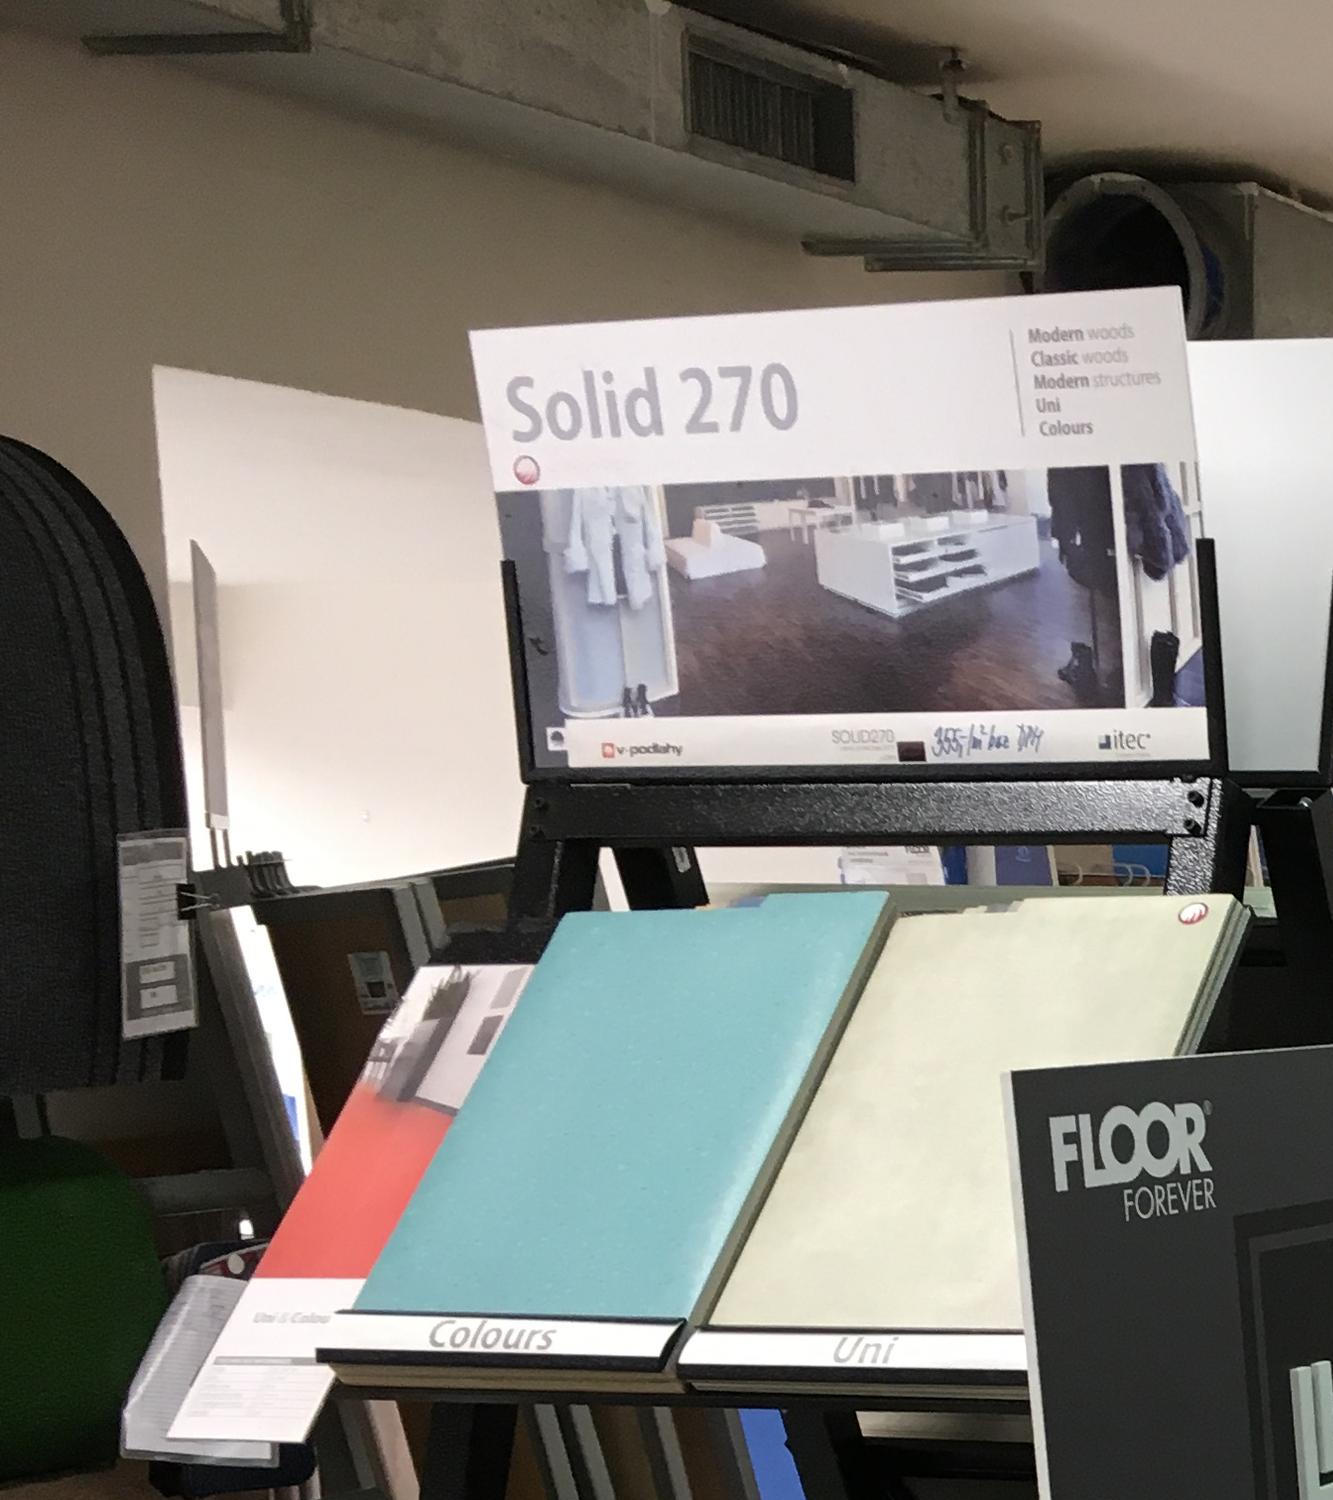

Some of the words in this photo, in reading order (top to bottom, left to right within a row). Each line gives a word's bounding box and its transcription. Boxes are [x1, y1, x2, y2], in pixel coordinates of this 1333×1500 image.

[1028, 327, 1084, 344] Modern
[1088, 324, 1135, 340] woods
[1031, 350, 1079, 367] Classic
[1082, 349, 1129, 364] woods
[1034, 373, 1090, 389] Modern
[1093, 371, 1162, 386] structures
[506, 366, 664, 443] Solid
[680, 363, 800, 433] 270
[1036, 398, 1061, 413] Uni
[1039, 420, 1094, 436] Colours
[1049, 1102, 1212, 1192] FLOOR
[1124, 1179, 1217, 1222] FOREVER
[291, 1311, 331, 1324] Colou
[428, 1318, 557, 1352] Colours
[831, 1336, 896, 1366] Uni
